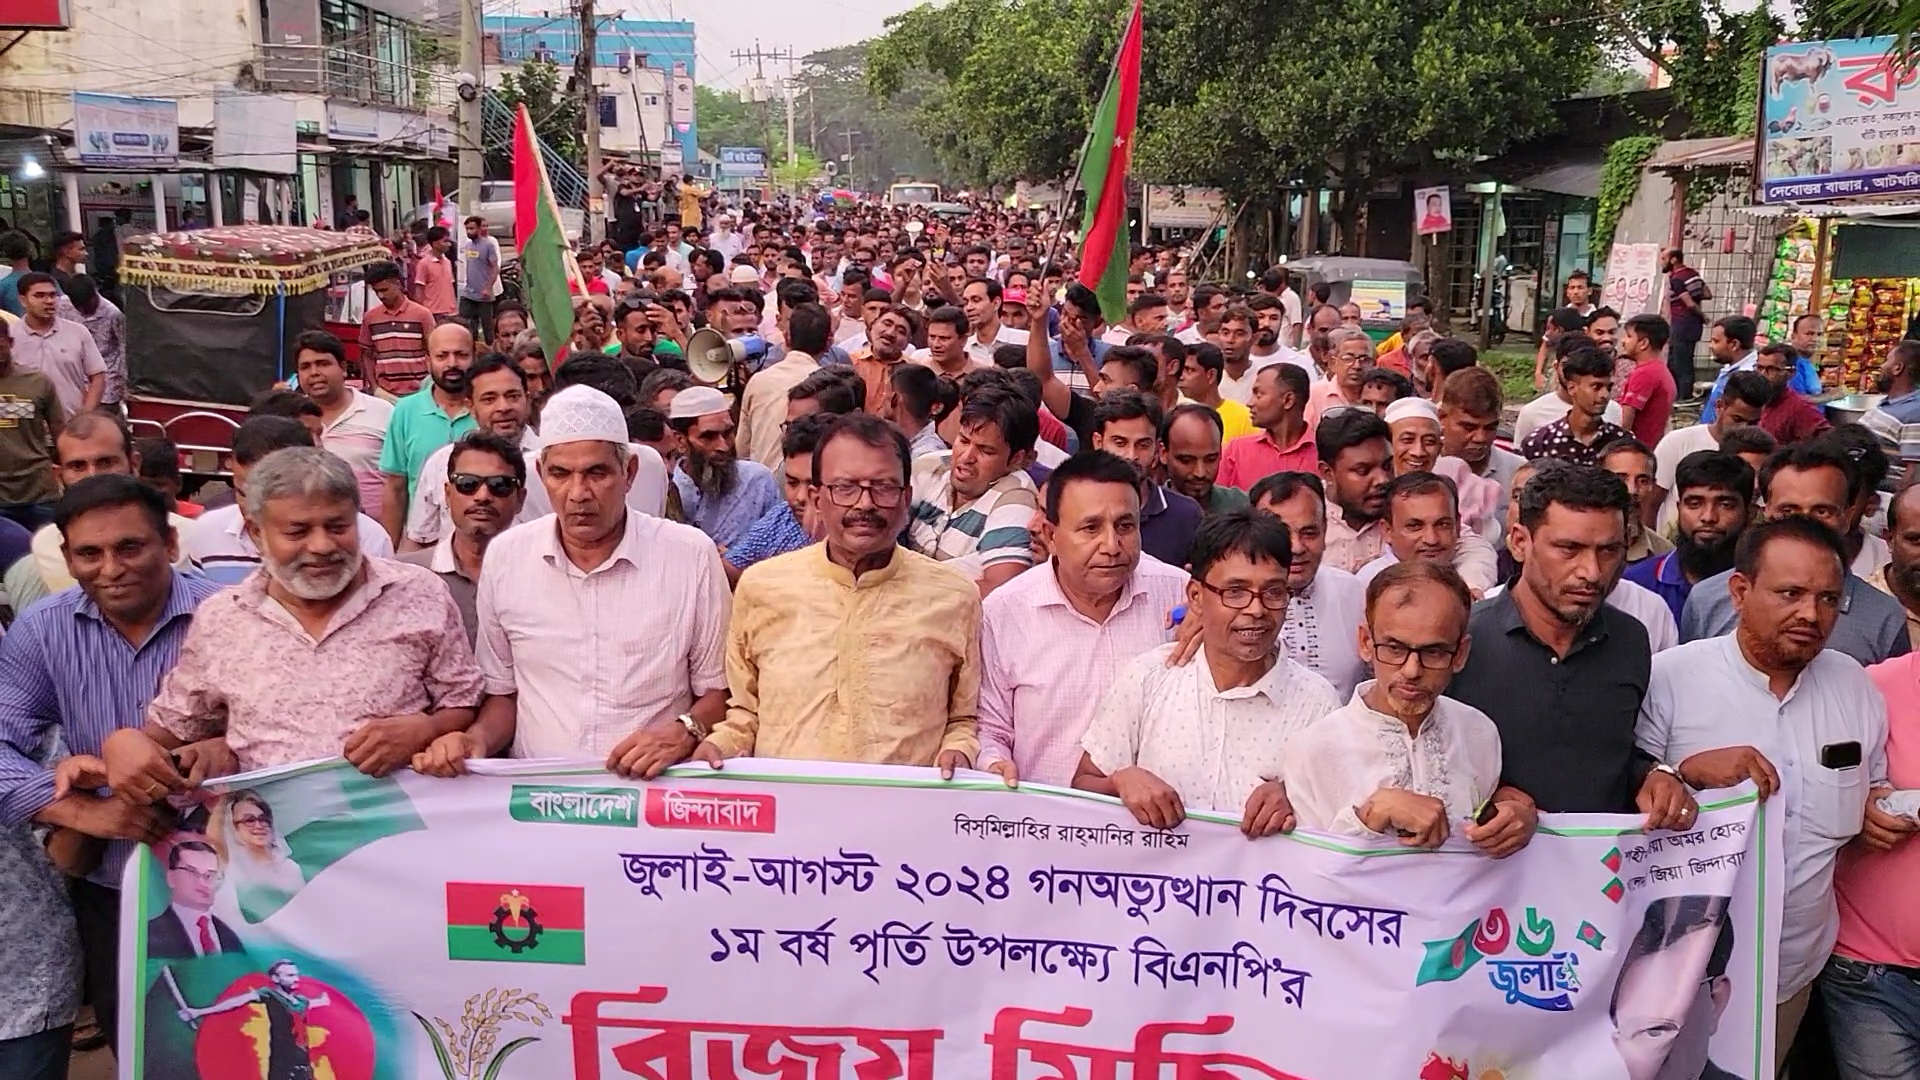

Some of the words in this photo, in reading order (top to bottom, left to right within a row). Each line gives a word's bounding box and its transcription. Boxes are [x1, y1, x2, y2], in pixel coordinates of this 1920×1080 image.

[529, 790, 637, 821] বাংলাদেশ
[661, 789, 762, 827] জিন্দাবাদ
[1140, 829, 1190, 849] রাহিম
[1666, 829, 1706, 849] অমর
[1710, 821, 1746, 842] হোক
[619, 842, 881, 901] জুলাই-আগস্ট
[896, 863, 1010, 905] ২০২৪
[1257, 873, 1409, 948] দিবসের
[1650, 864, 1683, 885] জিয়া
[710, 928, 766, 963] ১ম
[775, 917, 837, 966] বর্ষ
[941, 922, 1119, 983] উপলক্ষ্যে
[1473, 907, 1555, 957] ৩৬
[1486, 952, 1582, 1012] জুলাই
